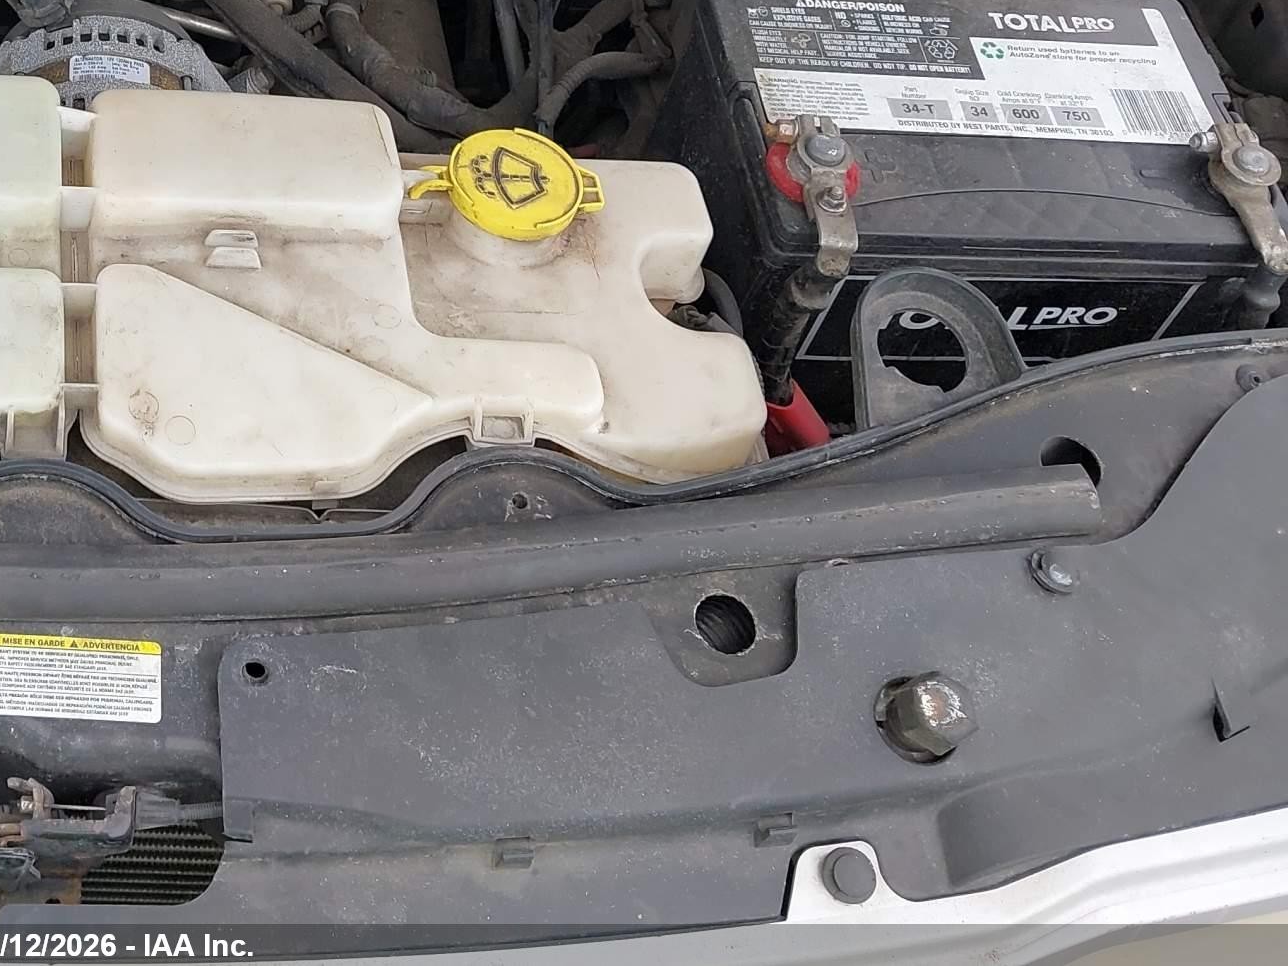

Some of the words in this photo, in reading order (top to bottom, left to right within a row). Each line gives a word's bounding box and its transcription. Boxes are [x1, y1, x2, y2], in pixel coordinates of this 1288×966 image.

[806, 0, 905, 13] DANGER/POISON
[987, 12, 1115, 33] TOTALPRO
[1007, 44, 1036, 52] Return
[1059, 47, 1097, 56] batteries
[1089, 56, 1117, 64] proper
[1119, 57, 1157, 66] recycling
[902, 103, 934, 115] 34-T
[970, 106, 988, 117] 34
[1012, 108, 1040, 120] 600
[1062, 111, 1091, 122] 750
[898, 119, 949, 129] DISTRIBUTED
[2, 637, 23, 645] MISE
[24, 638, 35, 646] EN
[37, 639, 66, 647] GARDE
[83, 641, 140, 652] ADVERTENCIA
